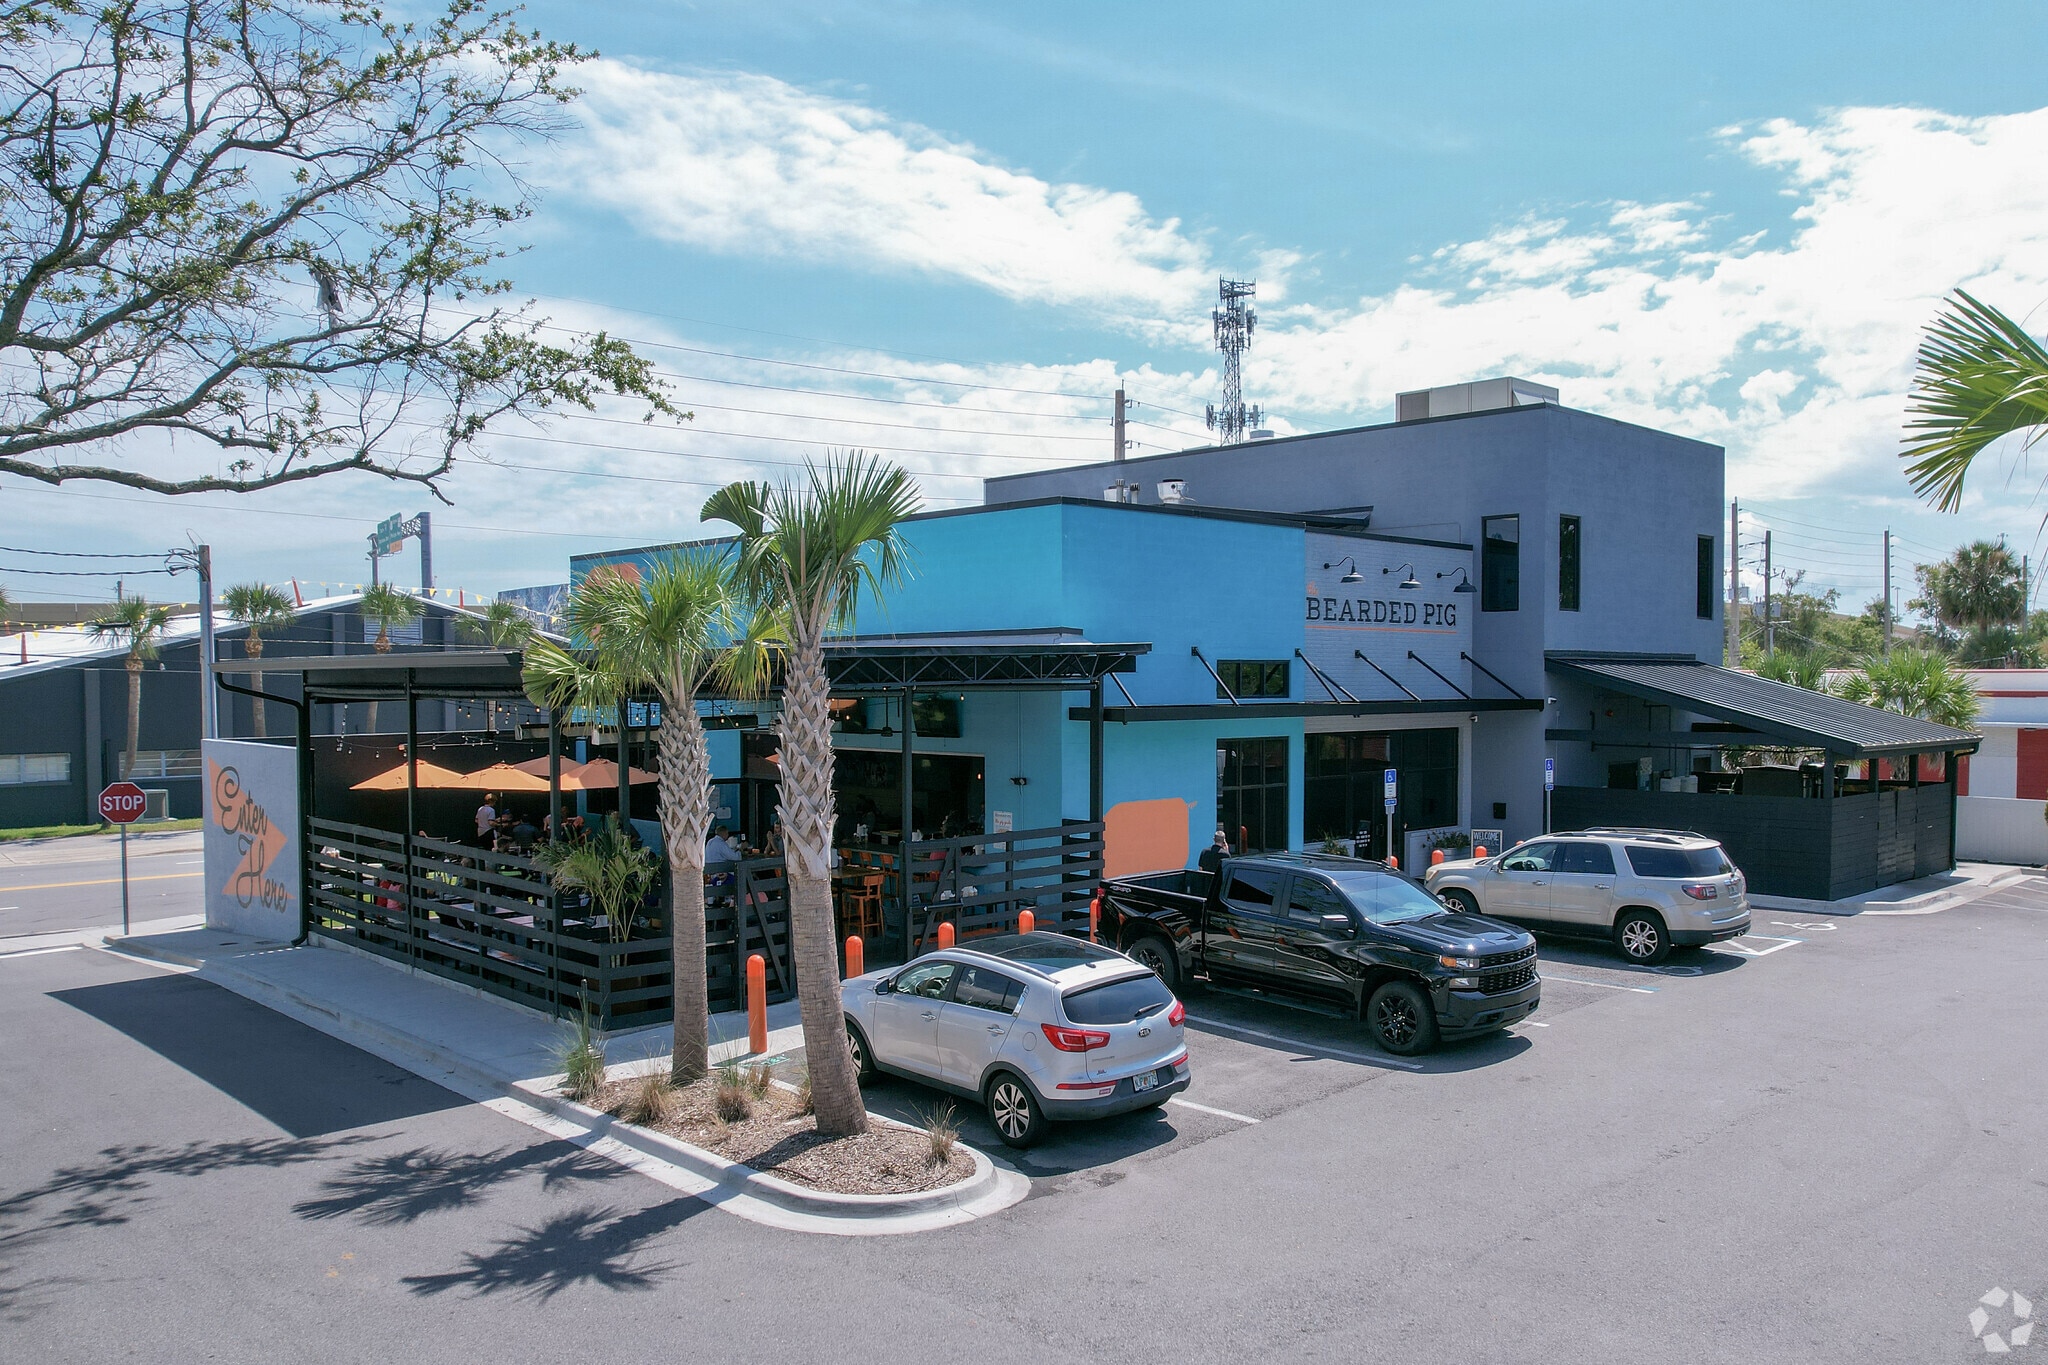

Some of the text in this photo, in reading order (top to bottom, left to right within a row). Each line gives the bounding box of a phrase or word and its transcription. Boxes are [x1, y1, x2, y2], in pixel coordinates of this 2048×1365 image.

[1306, 597, 1457, 626] BEARDED PIG
[103, 795, 143, 811] STOP
[216, 766, 268, 836] Enter
[1473, 832, 1499, 841] WELCOME
[236, 834, 287, 913] Here
